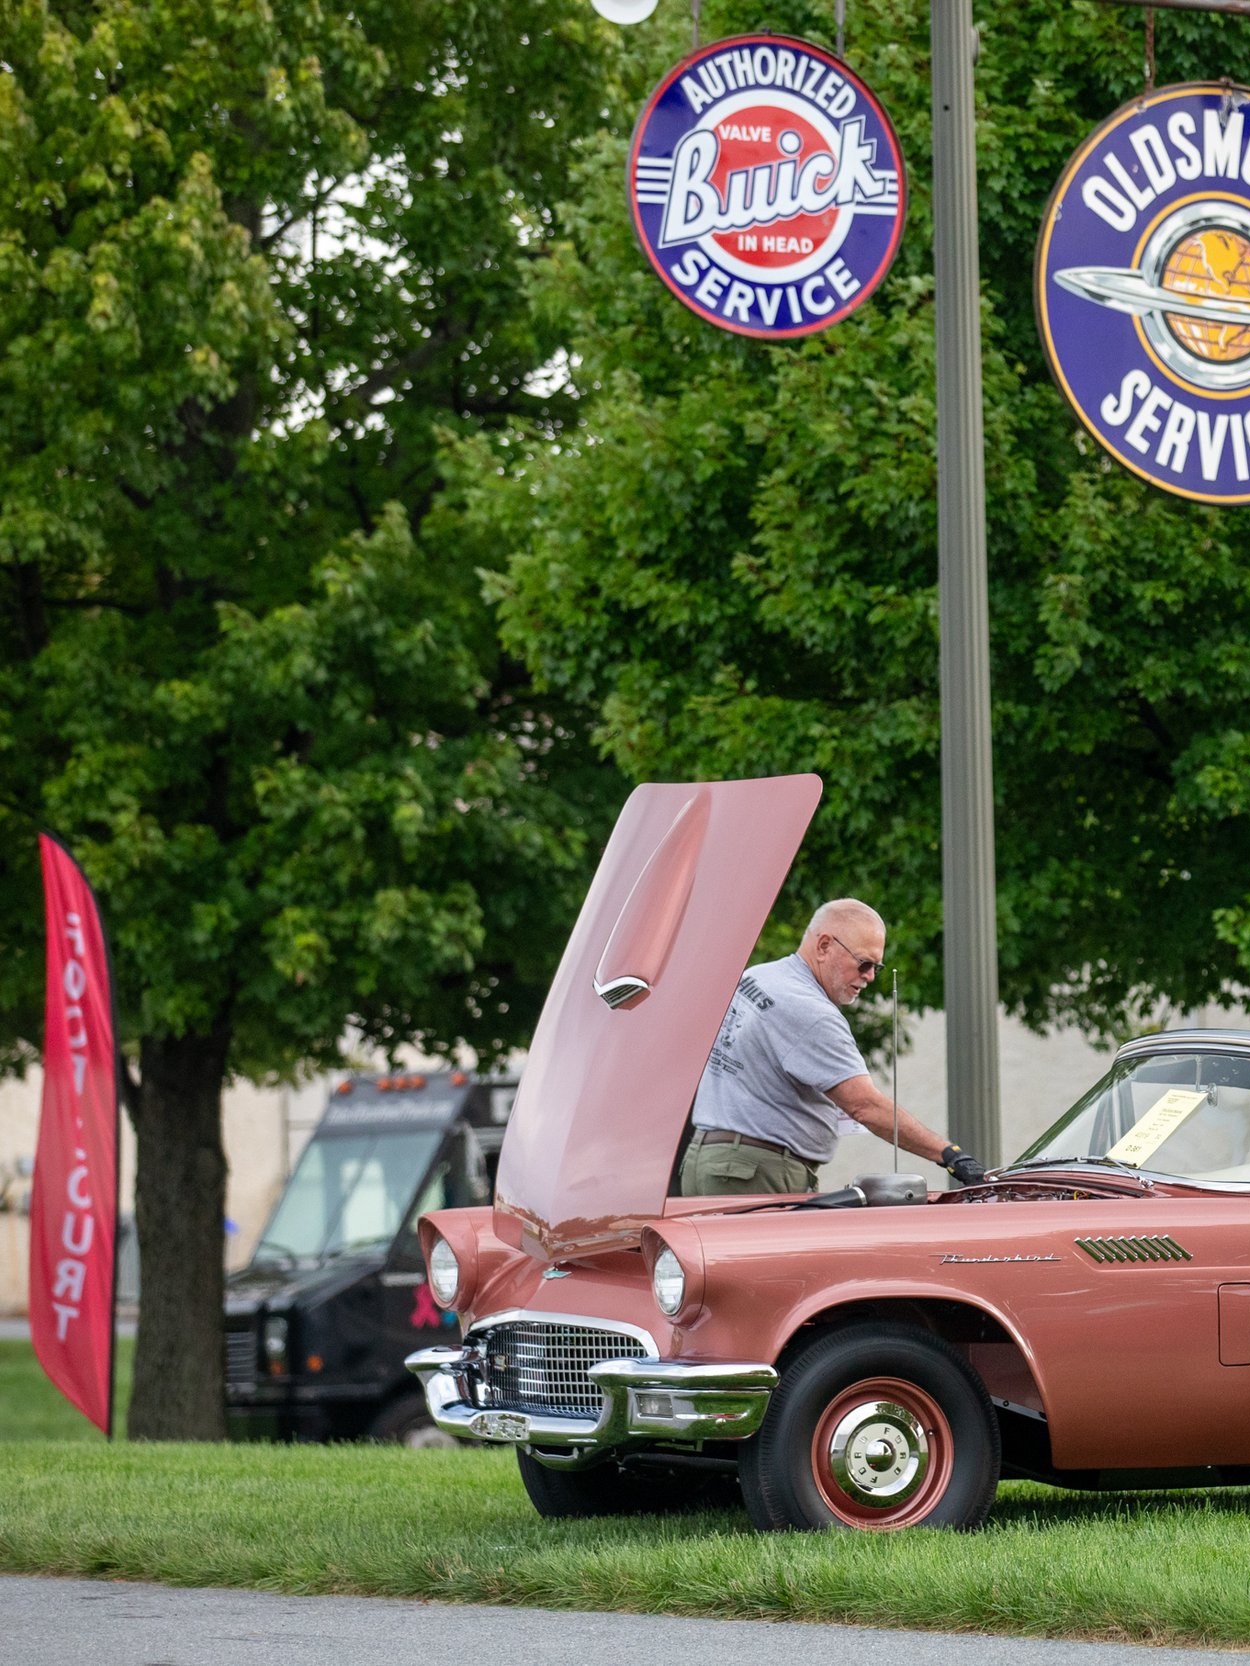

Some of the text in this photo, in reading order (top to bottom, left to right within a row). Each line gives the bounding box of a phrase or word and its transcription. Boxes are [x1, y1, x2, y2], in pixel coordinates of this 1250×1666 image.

[680, 47, 857, 119] AUTHORIZED
[719, 125, 772, 143] VALVE
[658, 115, 888, 249] Buick
[738, 234, 814, 254] IN HEAD
[670, 249, 861, 326] SERVICE
[928, 1253, 1062, 1265] Thunderbird
